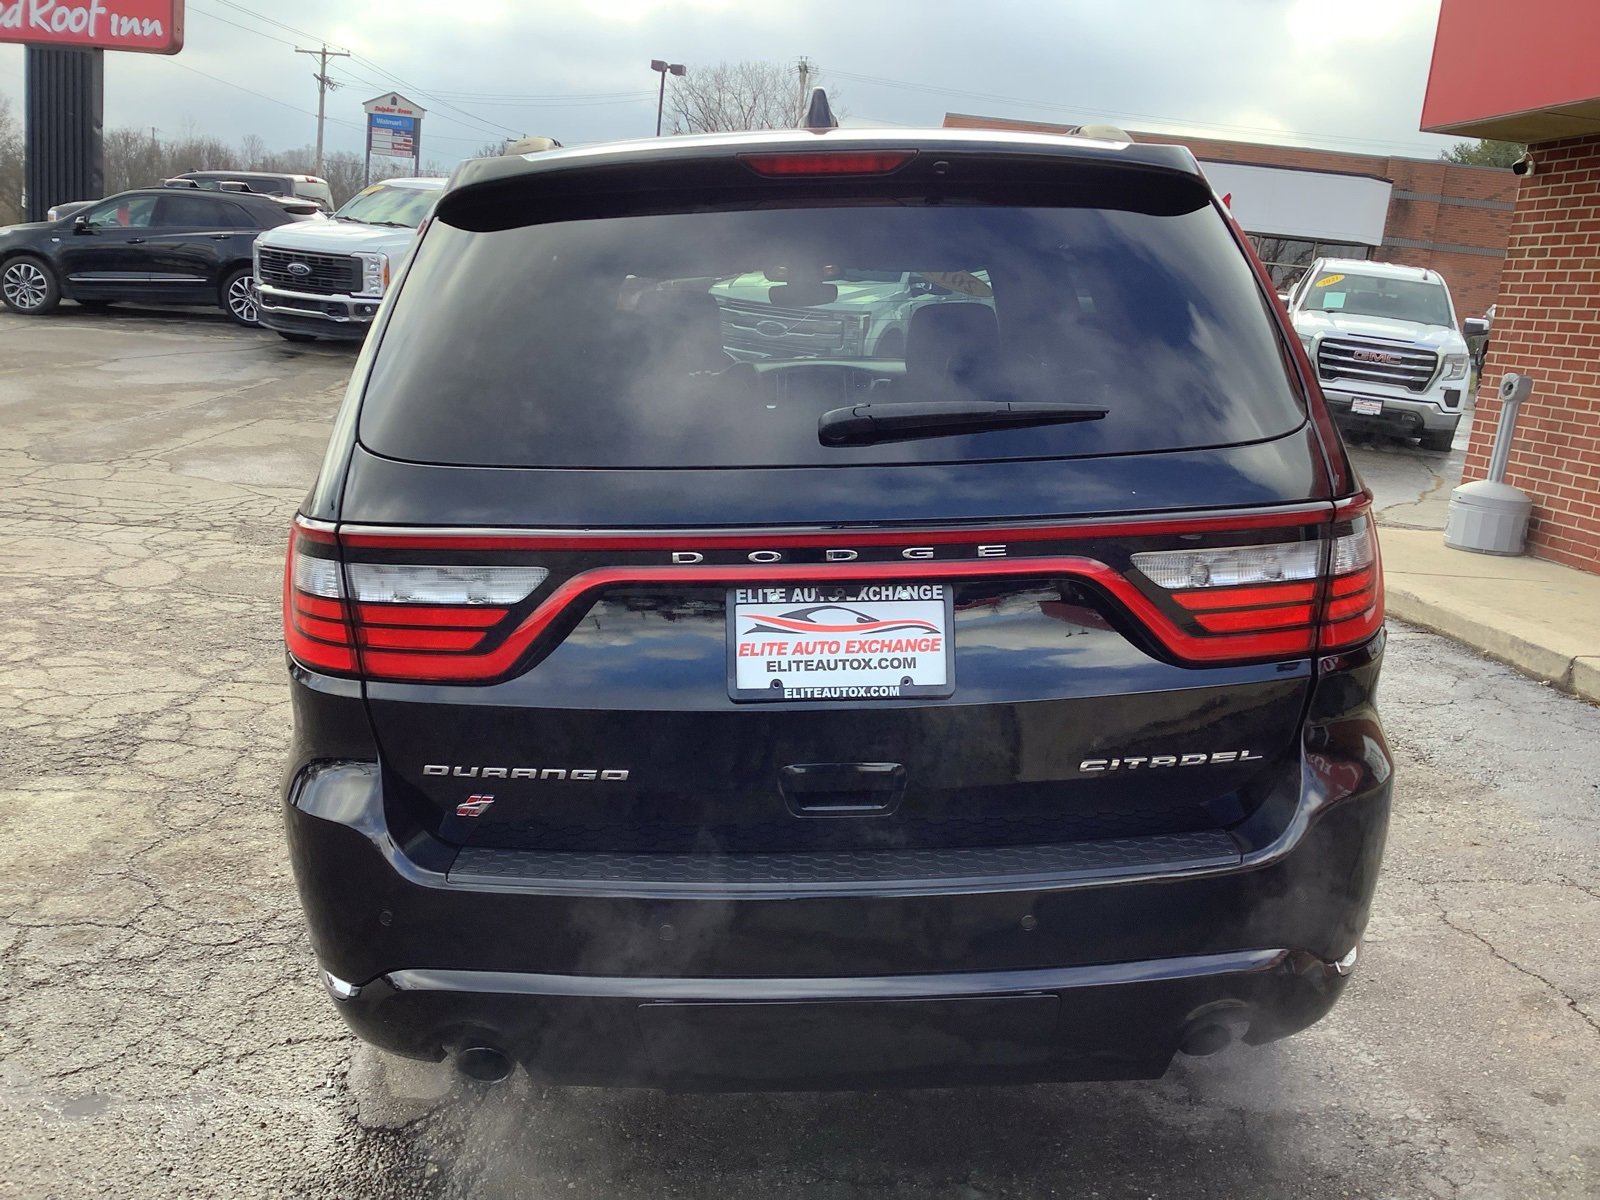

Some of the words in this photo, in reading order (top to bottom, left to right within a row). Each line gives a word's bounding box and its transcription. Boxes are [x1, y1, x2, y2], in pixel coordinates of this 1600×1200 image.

[376, 118, 402, 126] Walmart
[1321, 275, 1339, 285] 2021
[1353, 351, 1402, 364] GMC
[672, 545, 1007, 563] DODGE
[735, 588, 786, 603] ELITE
[846, 585, 944, 601] XCHANGE
[738, 641, 788, 657] ELITE
[791, 640, 841, 656] AUTO
[845, 637, 942, 654] EXCHANGE
[766, 657, 917, 673] ELITEAUTOX.COM
[783, 686, 900, 699] ELITEAUTOX.COM
[1079, 750, 1263, 772] CITADEL
[422, 764, 630, 781] DURANGO
